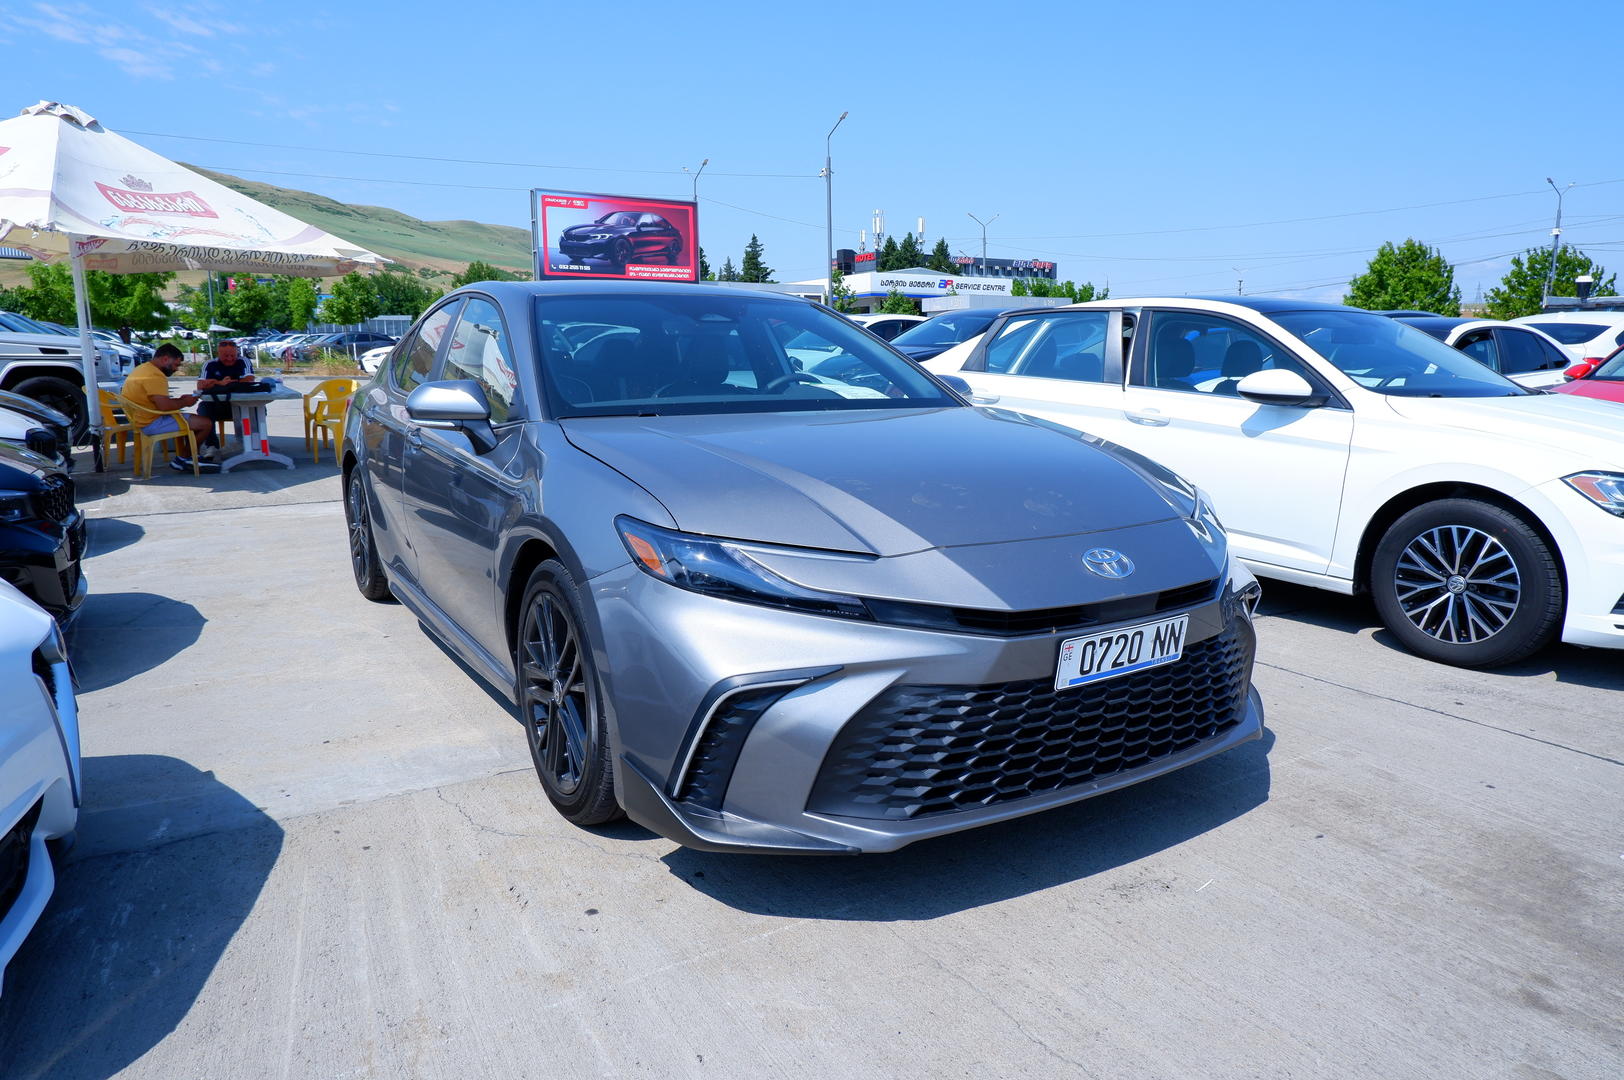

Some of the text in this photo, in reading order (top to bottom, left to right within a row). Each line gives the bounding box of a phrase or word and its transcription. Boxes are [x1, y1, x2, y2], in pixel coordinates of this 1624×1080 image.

[955, 282, 1006, 292] SERVICE CENTRE
[1079, 620, 1184, 676] 0720 NN
[1062, 651, 1073, 662] GE
